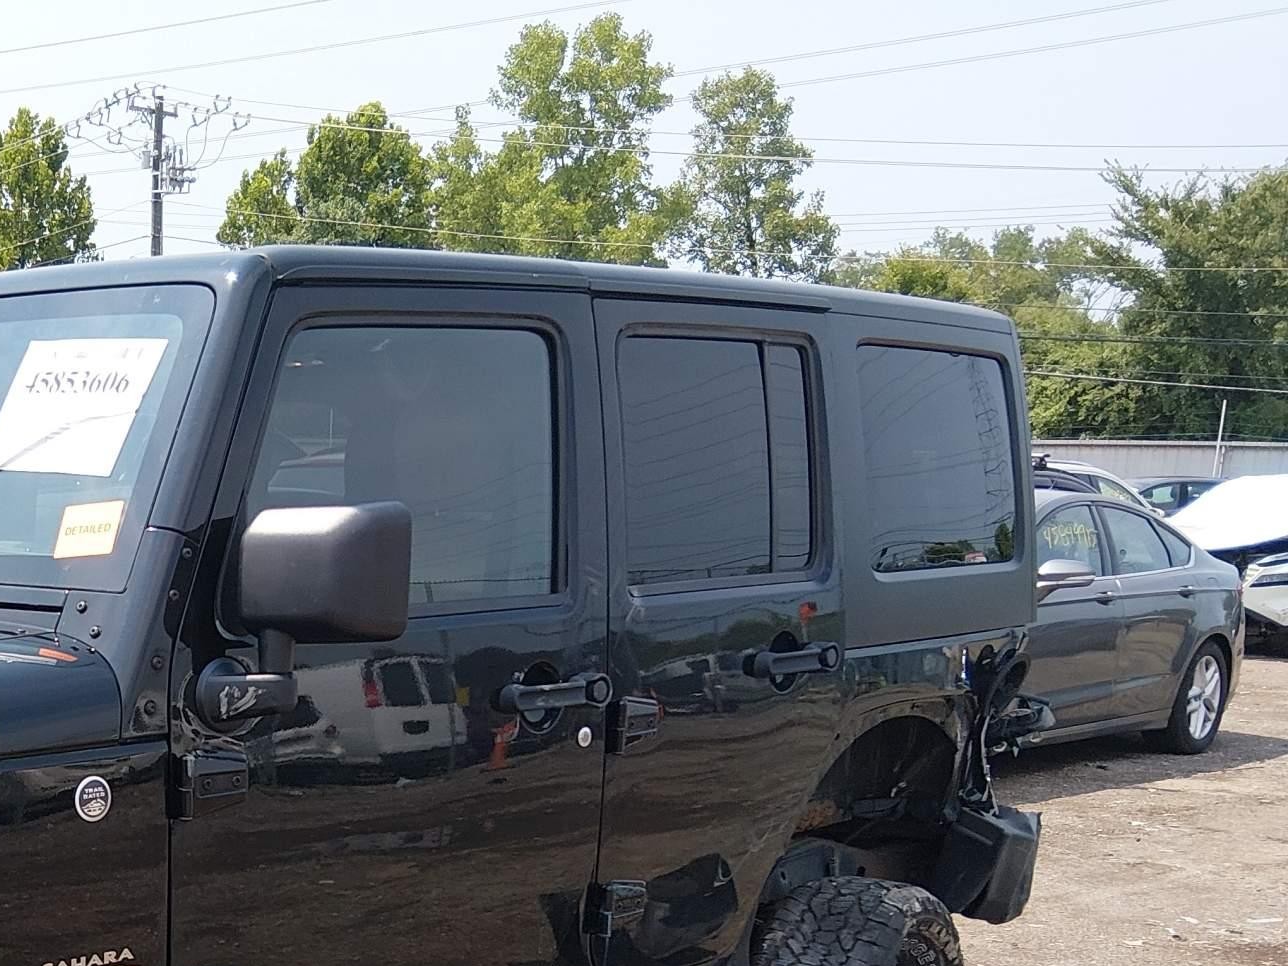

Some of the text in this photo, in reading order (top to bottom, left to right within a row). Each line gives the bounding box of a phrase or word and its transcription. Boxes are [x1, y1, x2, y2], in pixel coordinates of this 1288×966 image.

[25, 370, 130, 394] 45853606
[64, 523, 112, 537] DETAILED
[83, 786, 105, 795] TRAIL
[82, 792, 106, 801] RATED
